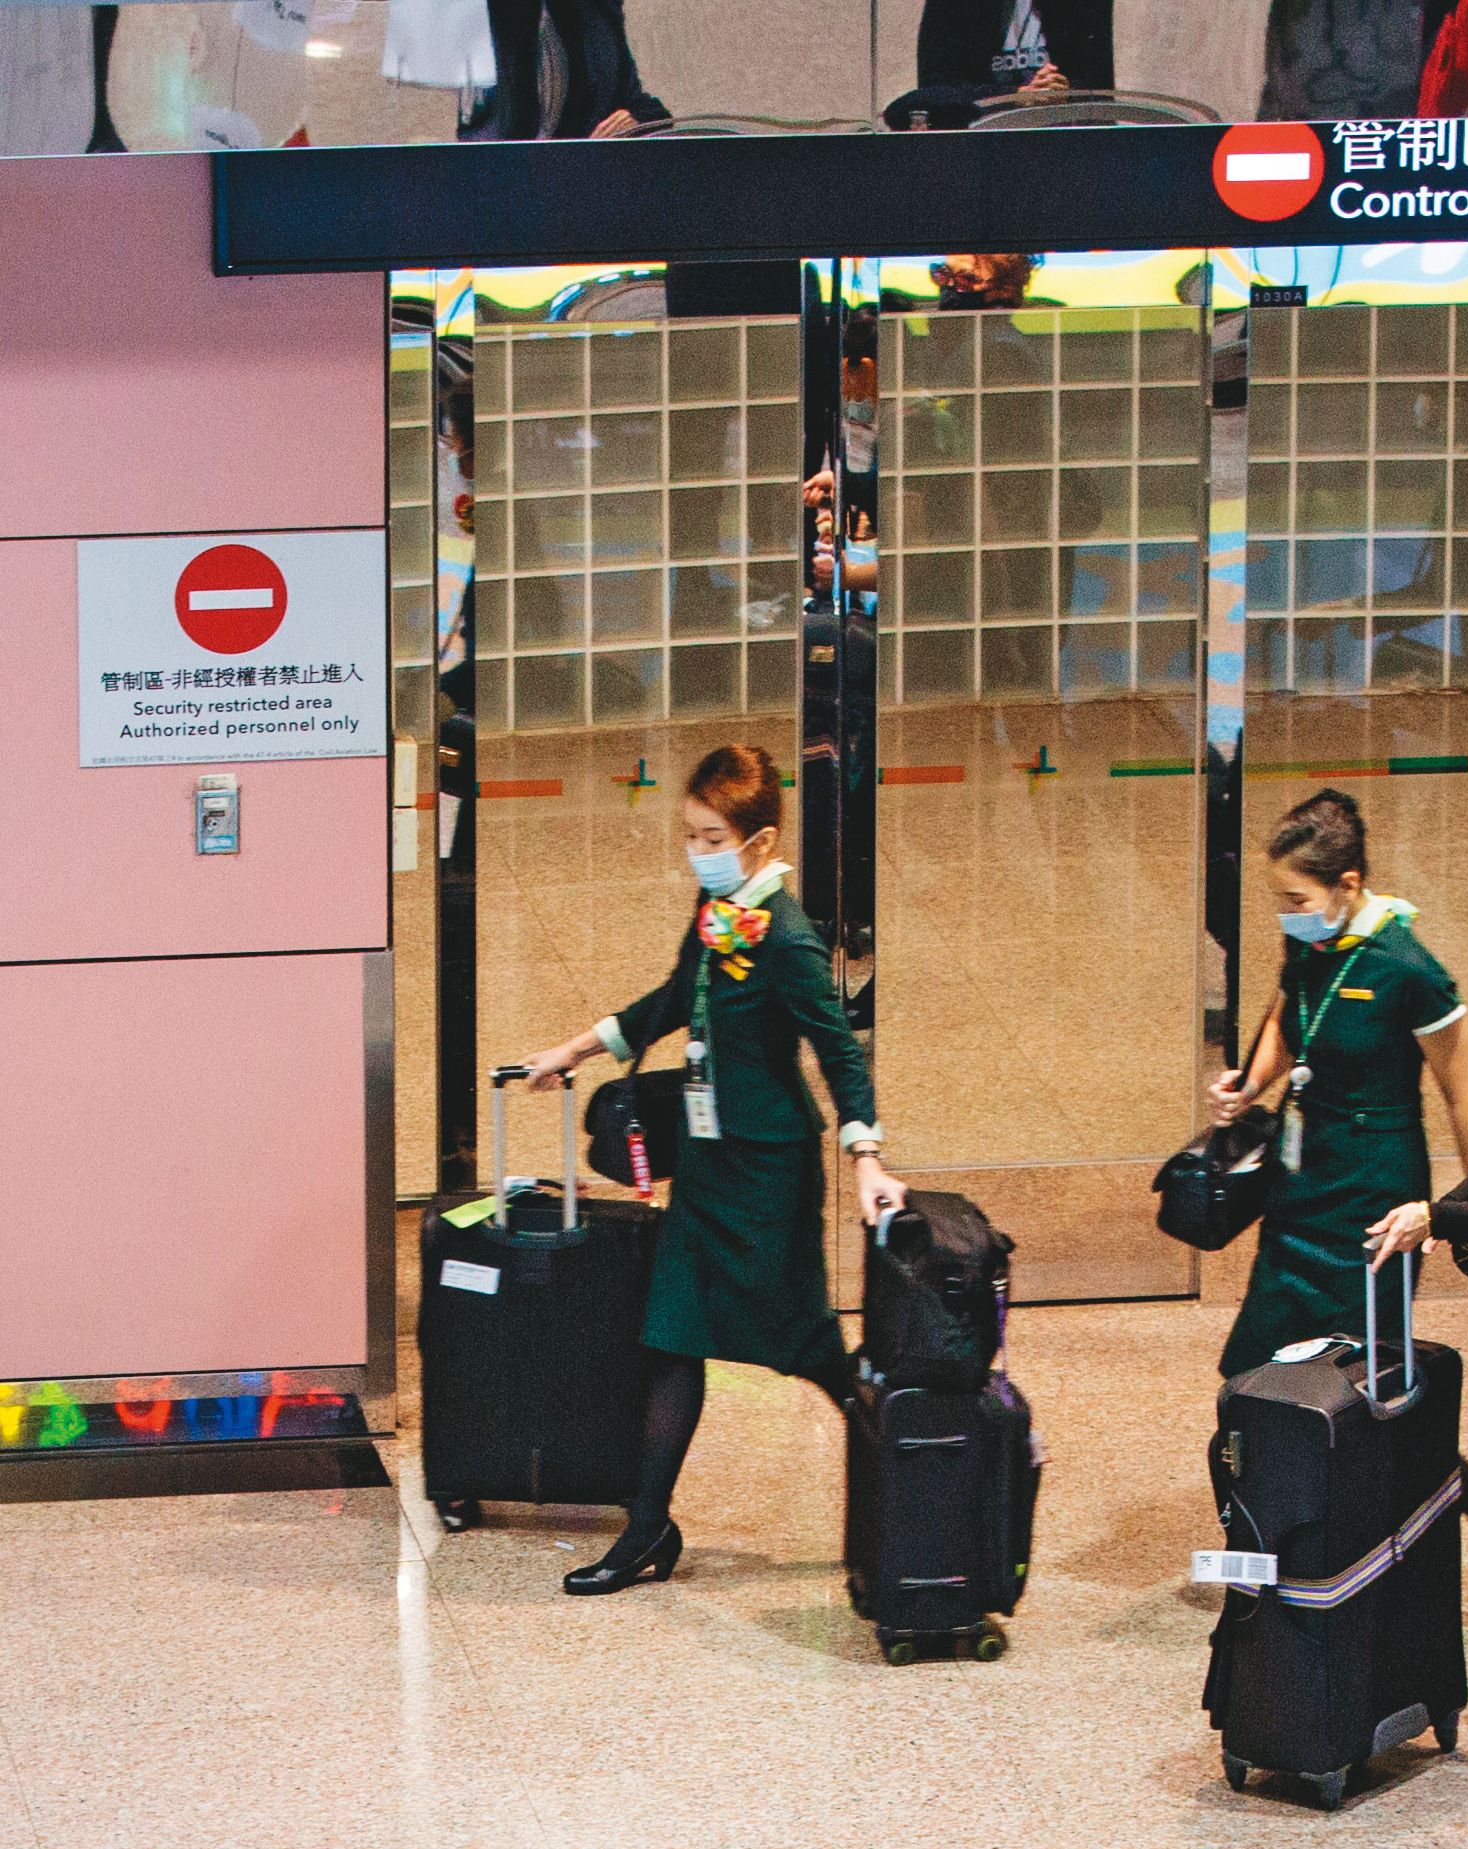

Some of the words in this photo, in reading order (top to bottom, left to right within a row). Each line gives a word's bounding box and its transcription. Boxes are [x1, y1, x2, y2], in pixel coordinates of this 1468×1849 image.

[1254, 291, 1304, 303] 1030A
[133, 700, 204, 718] Security
[208, 695, 290, 714] restricted
[295, 697, 333, 710] area
[119, 720, 220, 739] Authorized
[226, 716, 315, 739] personnel
[321, 715, 360, 734] only
